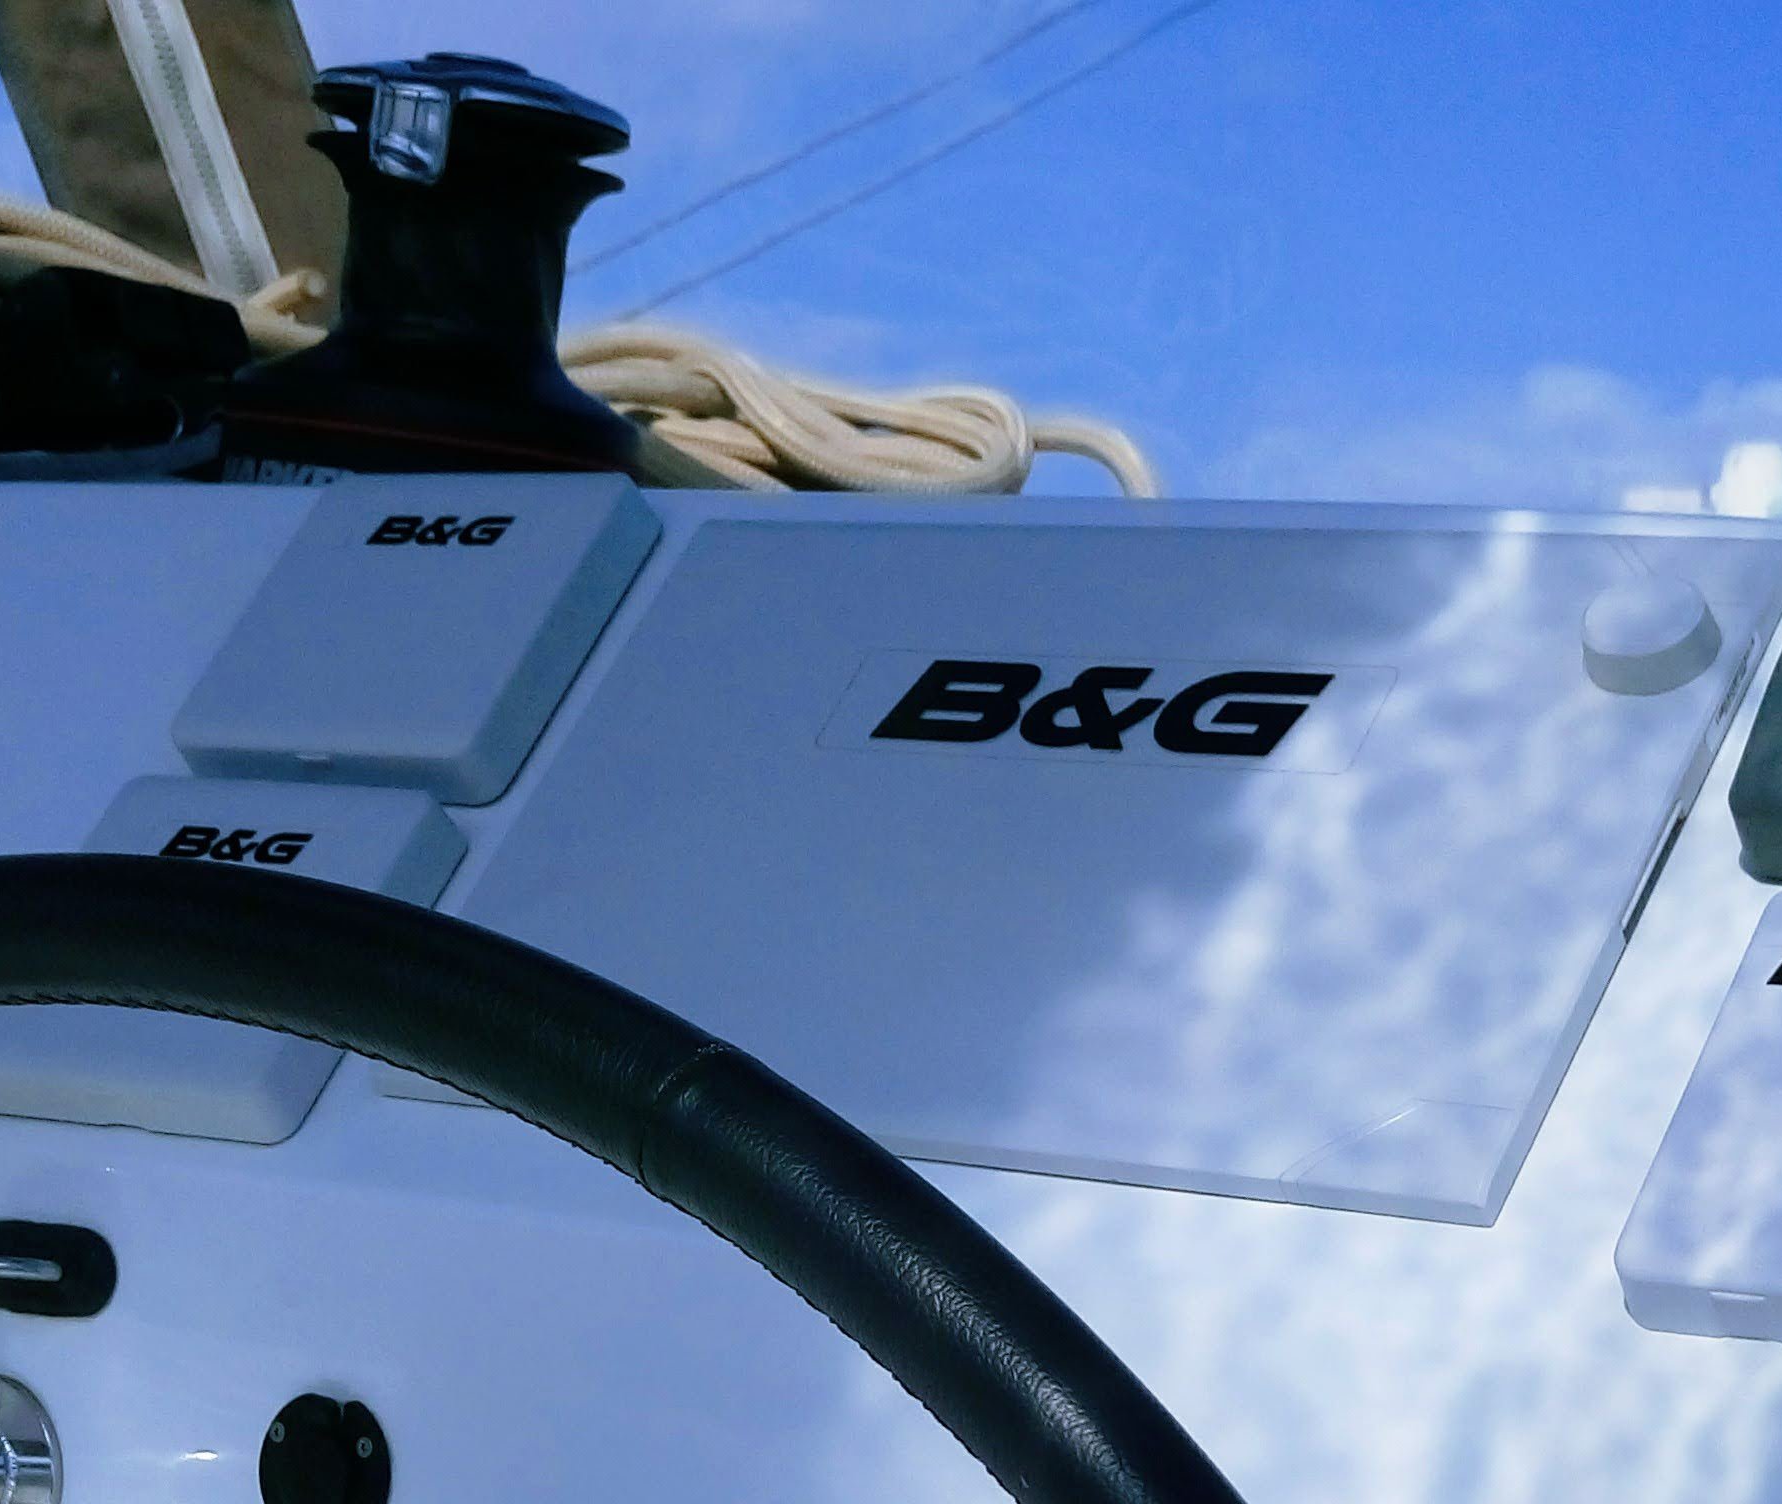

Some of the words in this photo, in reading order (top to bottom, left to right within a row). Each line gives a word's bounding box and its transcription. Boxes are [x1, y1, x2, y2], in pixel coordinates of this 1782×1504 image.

[365, 516, 516, 546] B&G
[869, 660, 1335, 757] B&G
[159, 825, 314, 864] B&G
